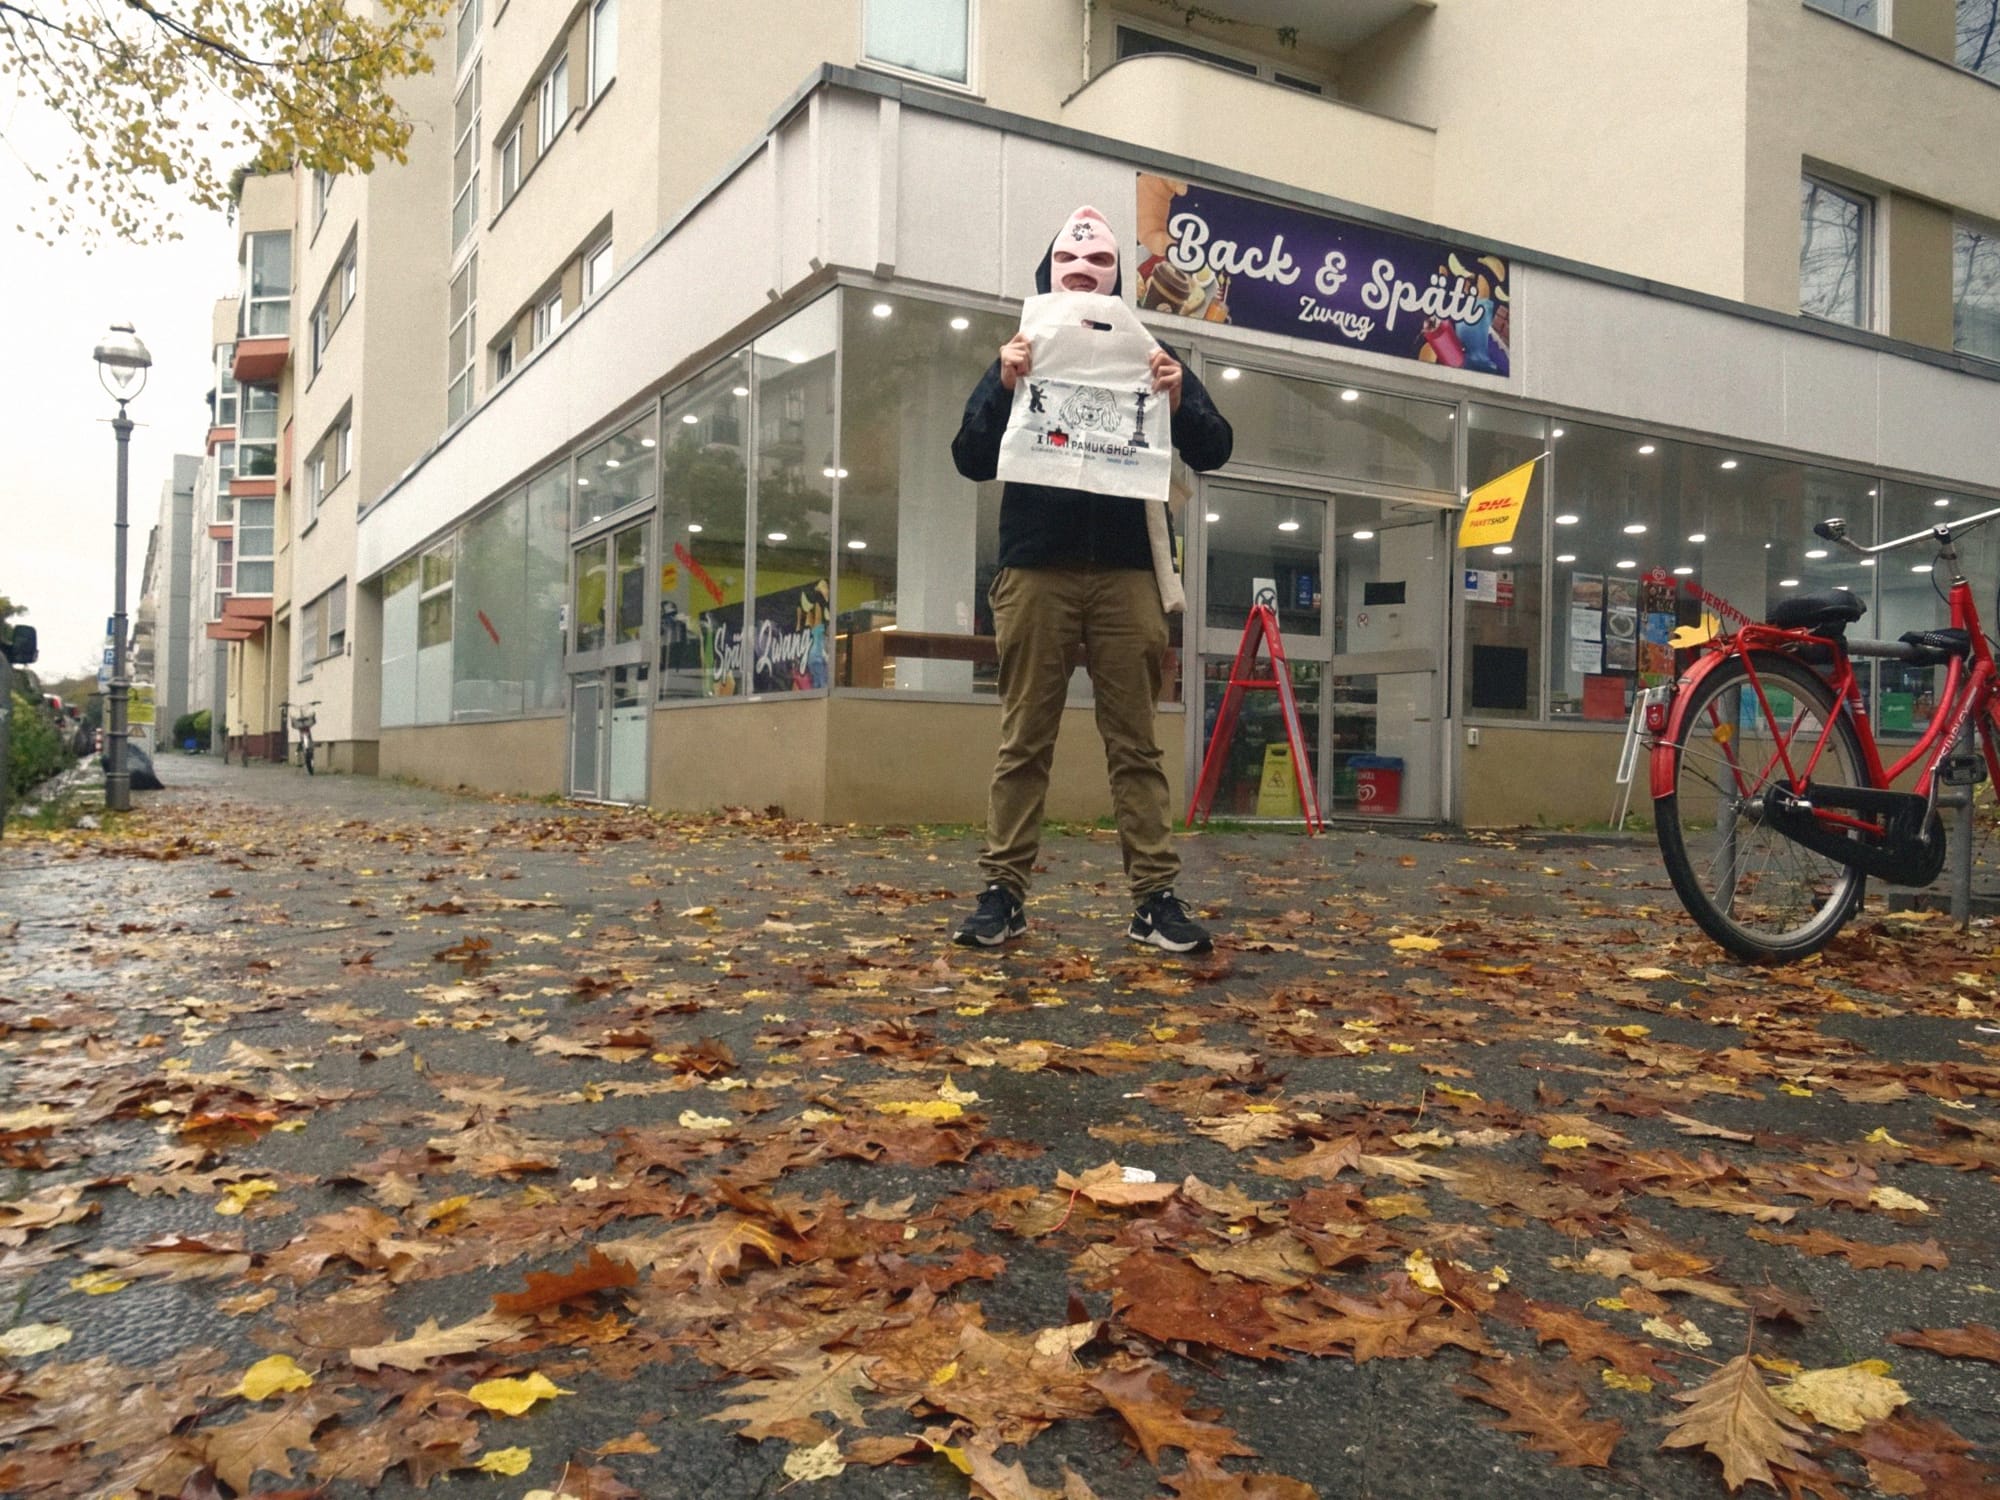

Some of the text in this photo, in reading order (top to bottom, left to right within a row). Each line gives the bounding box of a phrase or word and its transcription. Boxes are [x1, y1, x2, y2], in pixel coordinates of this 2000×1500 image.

[1167, 213, 1486, 331] Back & Späti
[1298, 295, 1375, 341] Zwang
[1071, 440, 1137, 456] PAMUKSHOP
[1477, 497, 1512, 512] DHL
